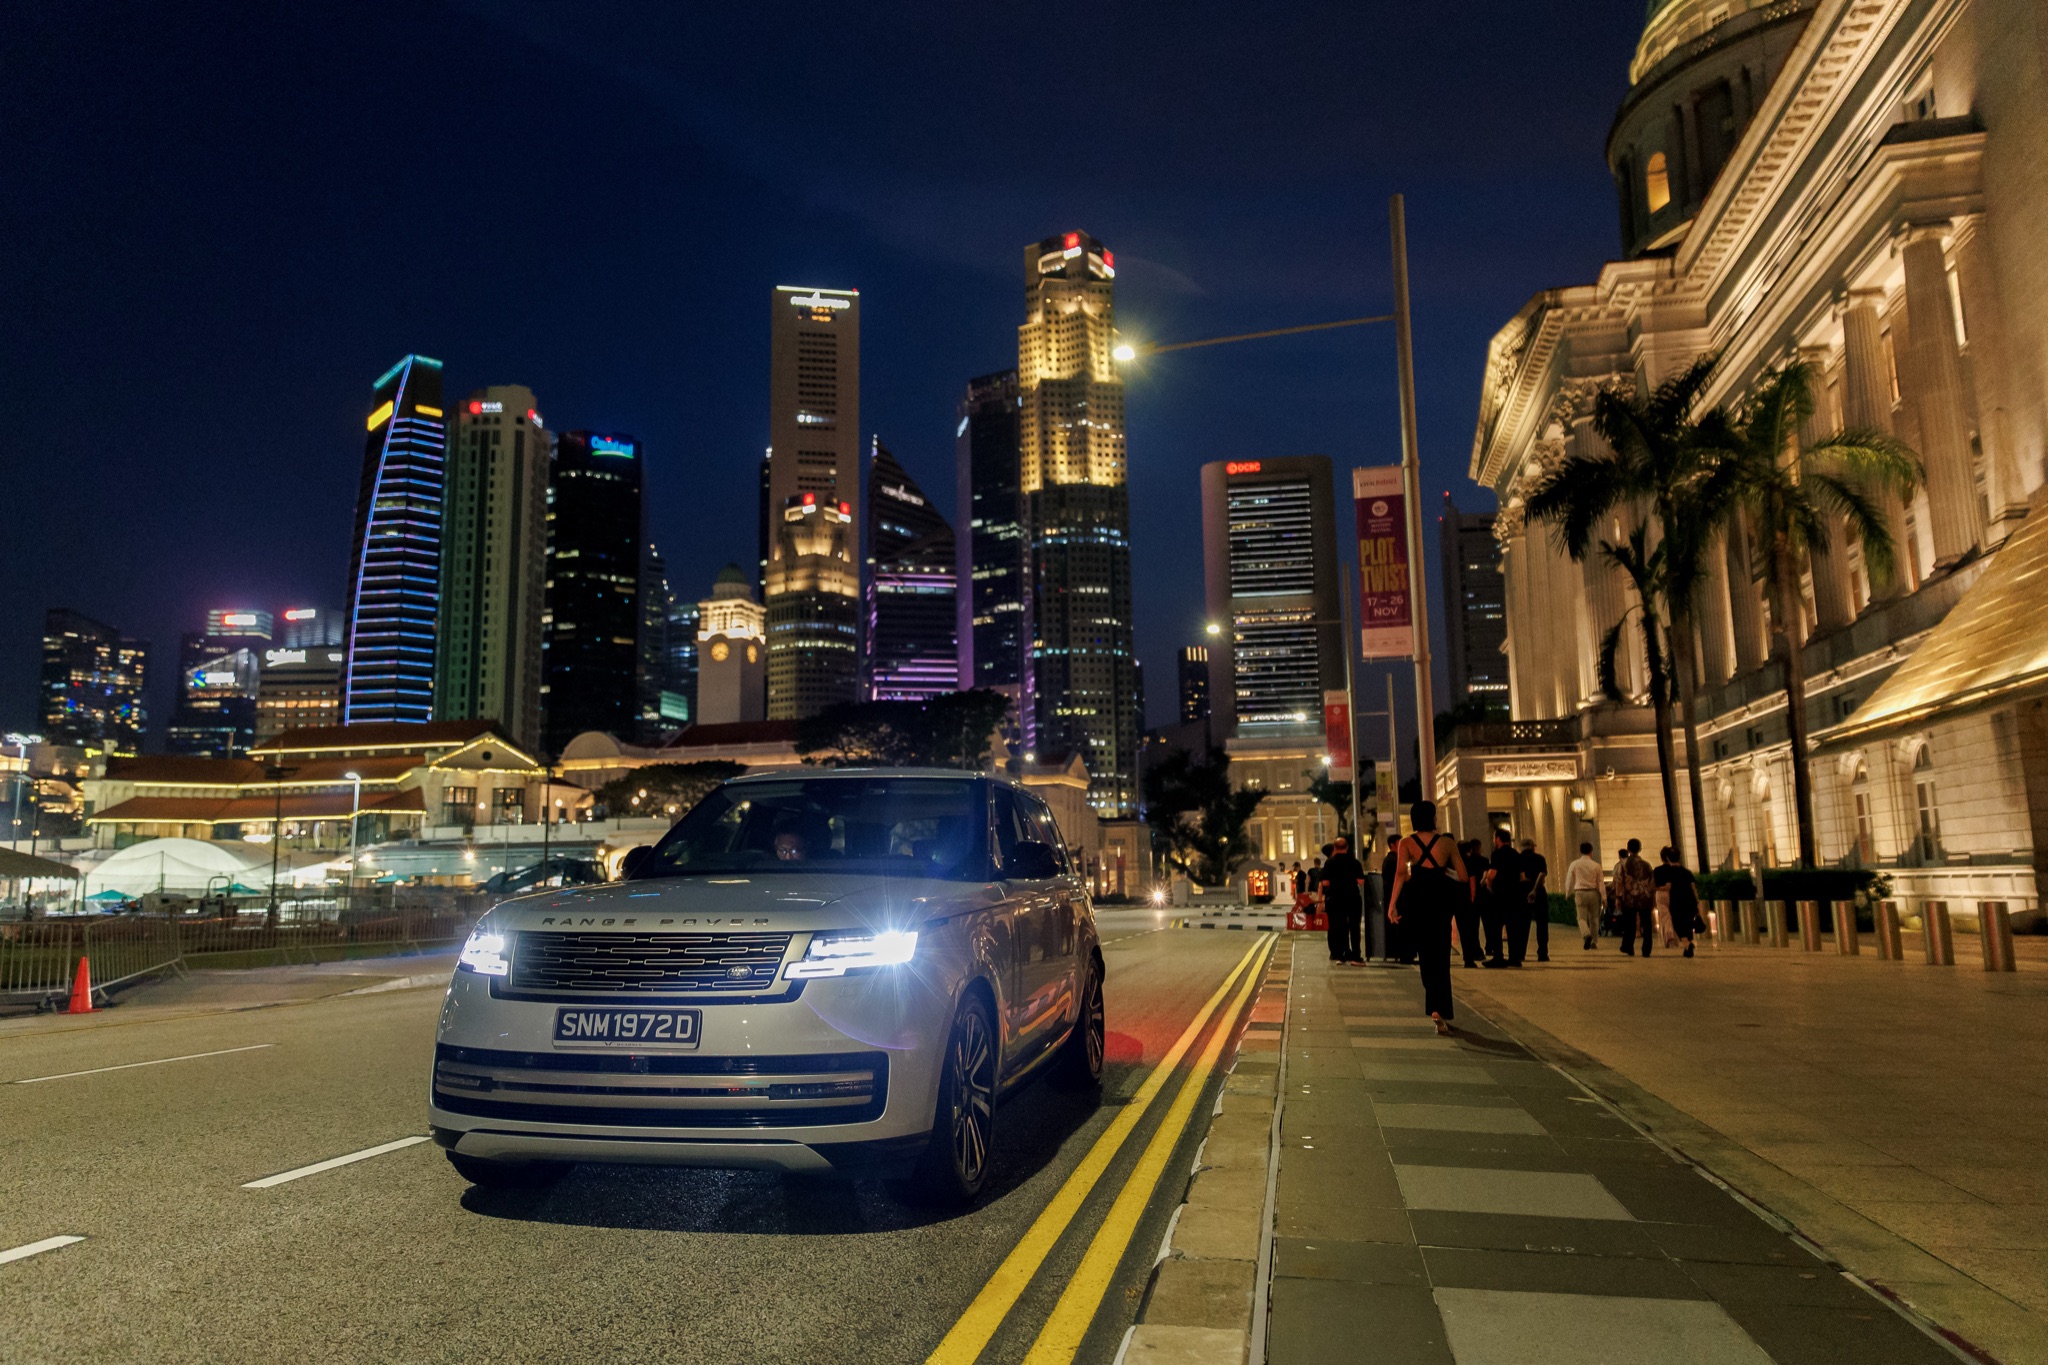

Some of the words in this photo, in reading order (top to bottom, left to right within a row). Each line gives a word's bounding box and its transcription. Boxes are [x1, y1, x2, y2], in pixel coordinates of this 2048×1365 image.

[1360, 537, 1396, 566] PLOT
[1361, 563, 1407, 592] TWIST
[1367, 597, 1378, 607] 17
[1390, 595, 1404, 605] 26
[1373, 607, 1398, 617] NOV
[541, 918, 638, 927] RANGE
[659, 918, 770, 926] ROVER
